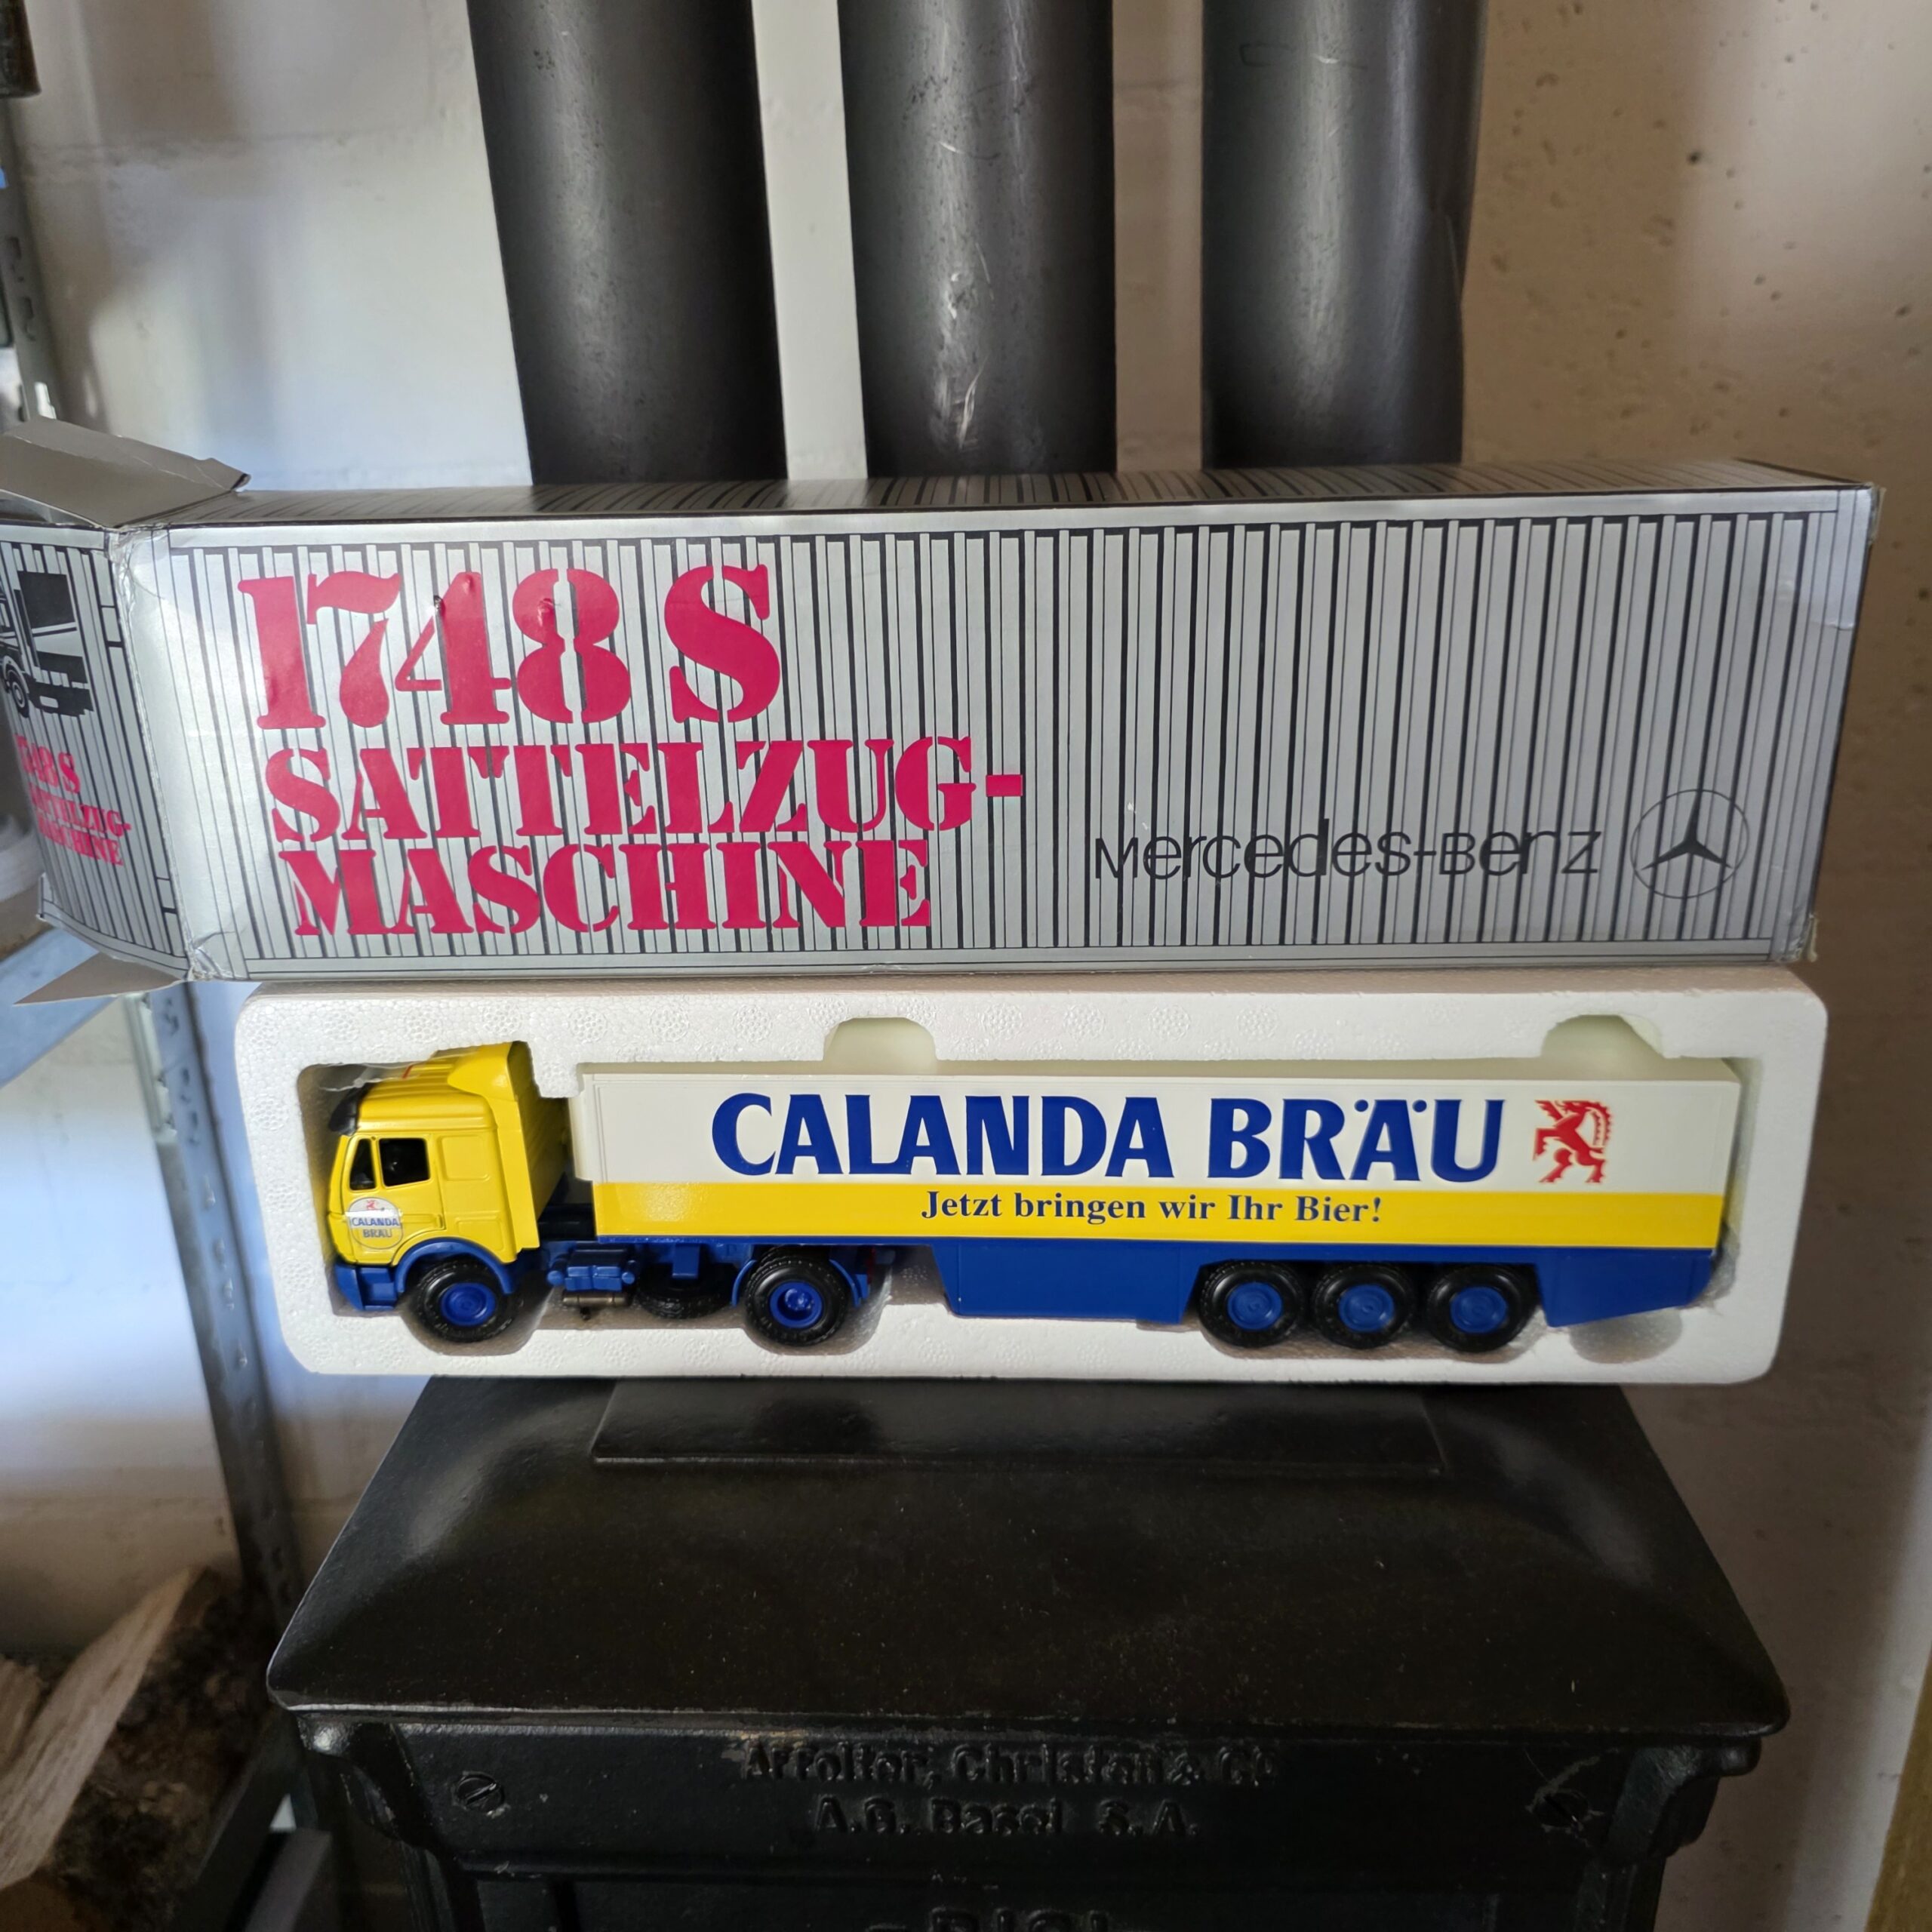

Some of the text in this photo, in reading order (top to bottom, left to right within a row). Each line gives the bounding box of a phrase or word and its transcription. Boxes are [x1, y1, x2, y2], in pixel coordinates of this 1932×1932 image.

[238, 564, 781, 729] 1748 S
[58, 752, 81, 795] S
[265, 736, 1024, 842] SATTELZUG-
[1095, 818, 1602, 880] Mercedes-Benz
[277, 839, 931, 937] MASCHINE
[712, 1093, 1503, 1183] CALANDA BRÄU
[352, 1217, 399, 1226] CALANDA
[921, 1191, 1382, 1225] Jetzt bringen wir Ihr Bier!
